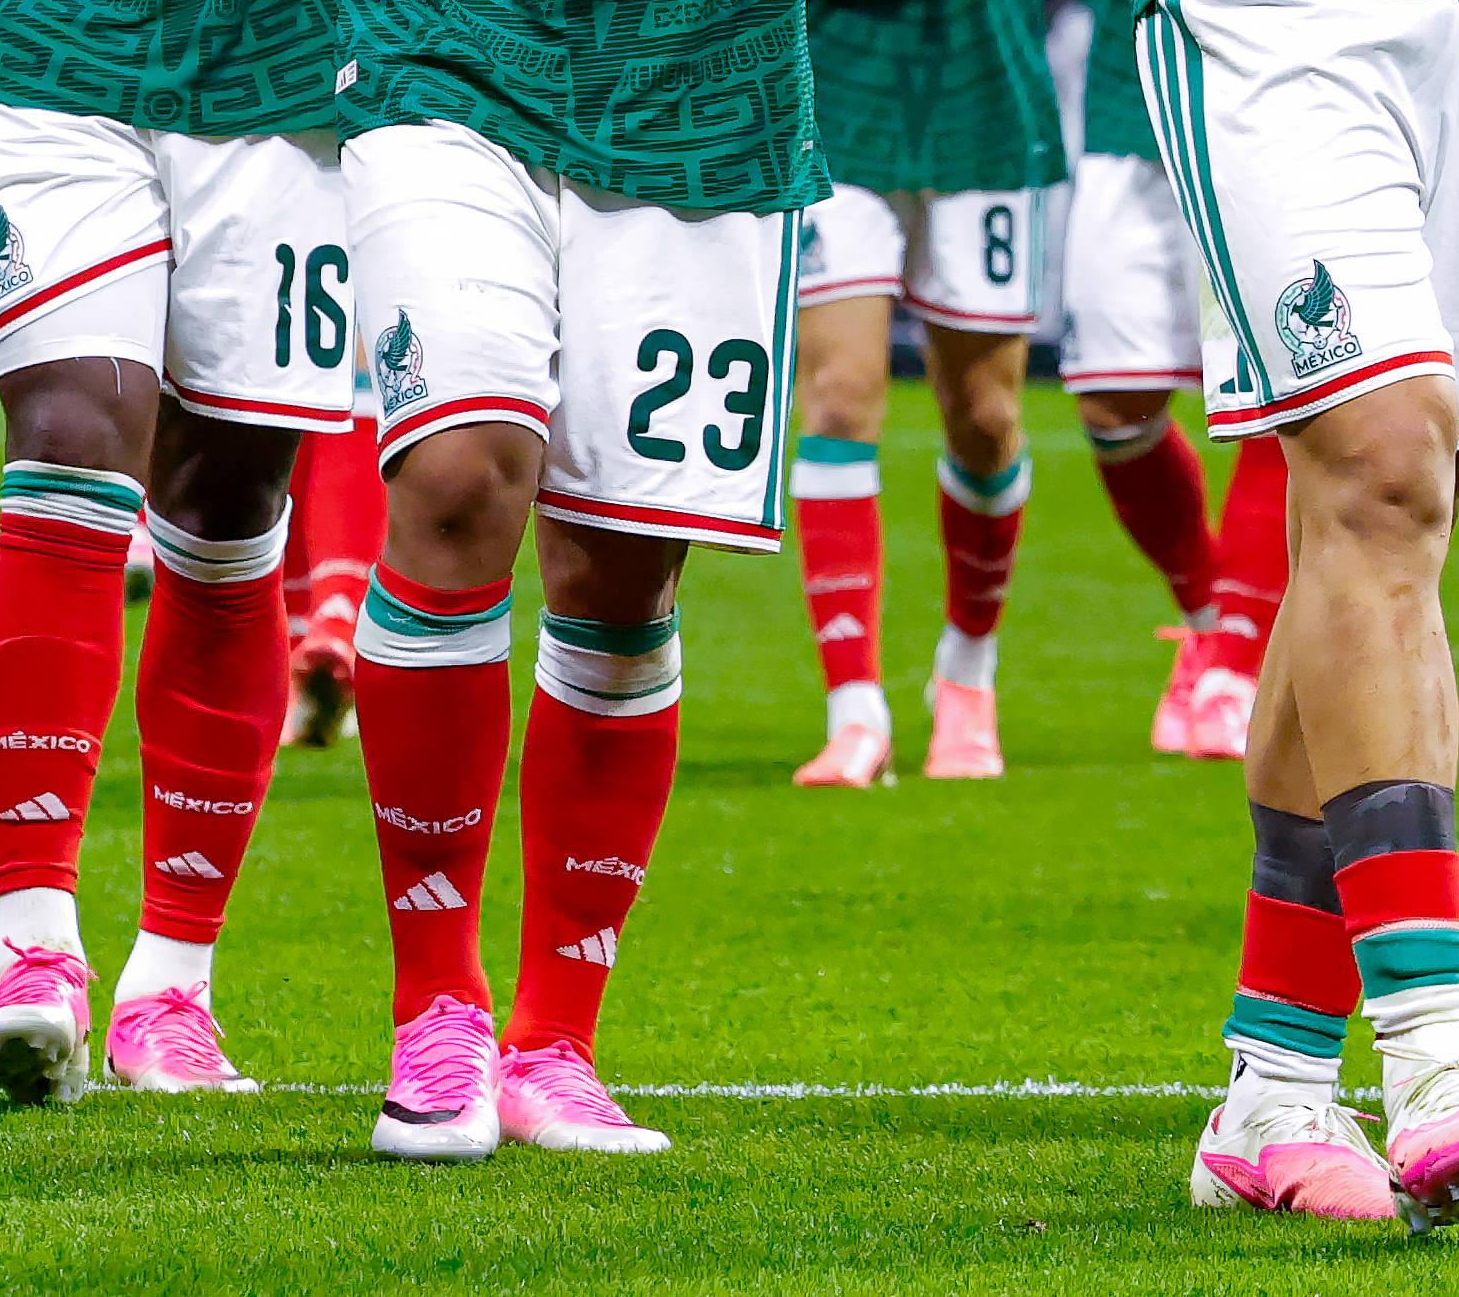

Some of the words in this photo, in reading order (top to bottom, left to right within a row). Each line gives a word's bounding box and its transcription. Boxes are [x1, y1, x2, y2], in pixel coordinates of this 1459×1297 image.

[984, 204, 1014, 285] 8
[275, 243, 350, 369] 16
[1295, 341, 1358, 374] MÉXICO
[627, 328, 770, 472] 23
[153, 784, 254, 816] MÉXICO
[374, 802, 482, 835] MÉXICO
